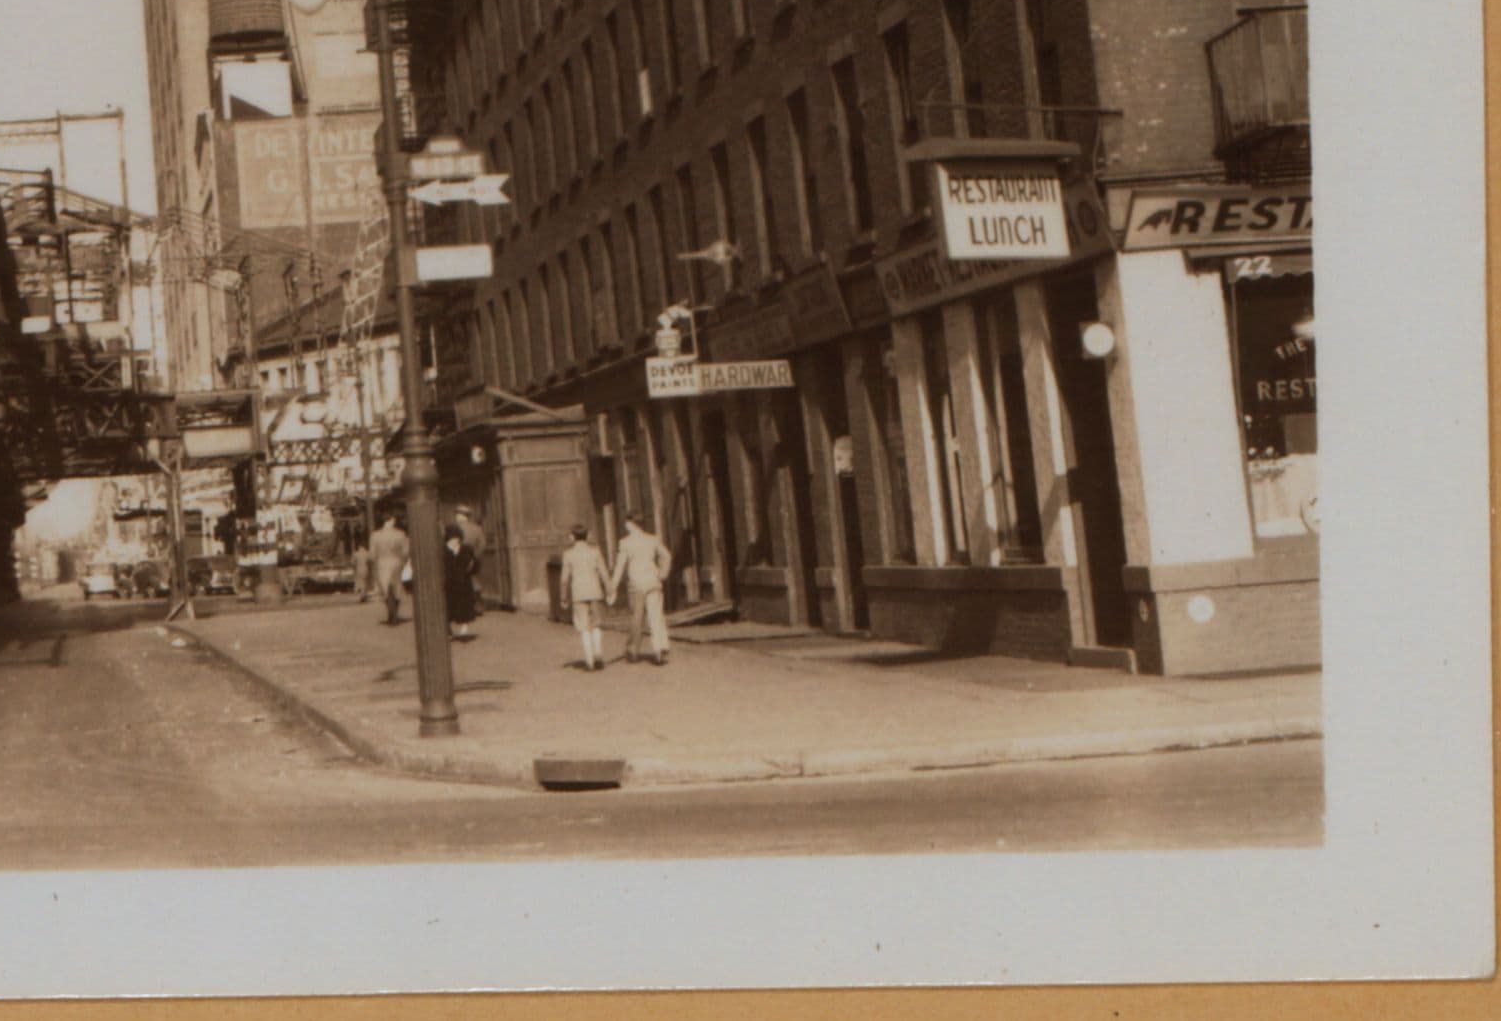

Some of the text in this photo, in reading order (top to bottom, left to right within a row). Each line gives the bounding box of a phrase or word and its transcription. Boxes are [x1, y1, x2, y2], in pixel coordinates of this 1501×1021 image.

[1169, 196, 1313, 235] REST
[967, 214, 1048, 246] LUNCH
[1233, 255, 1274, 277] 22
[1275, 336, 1308, 361] THE
[650, 362, 694, 379] DEVOE
